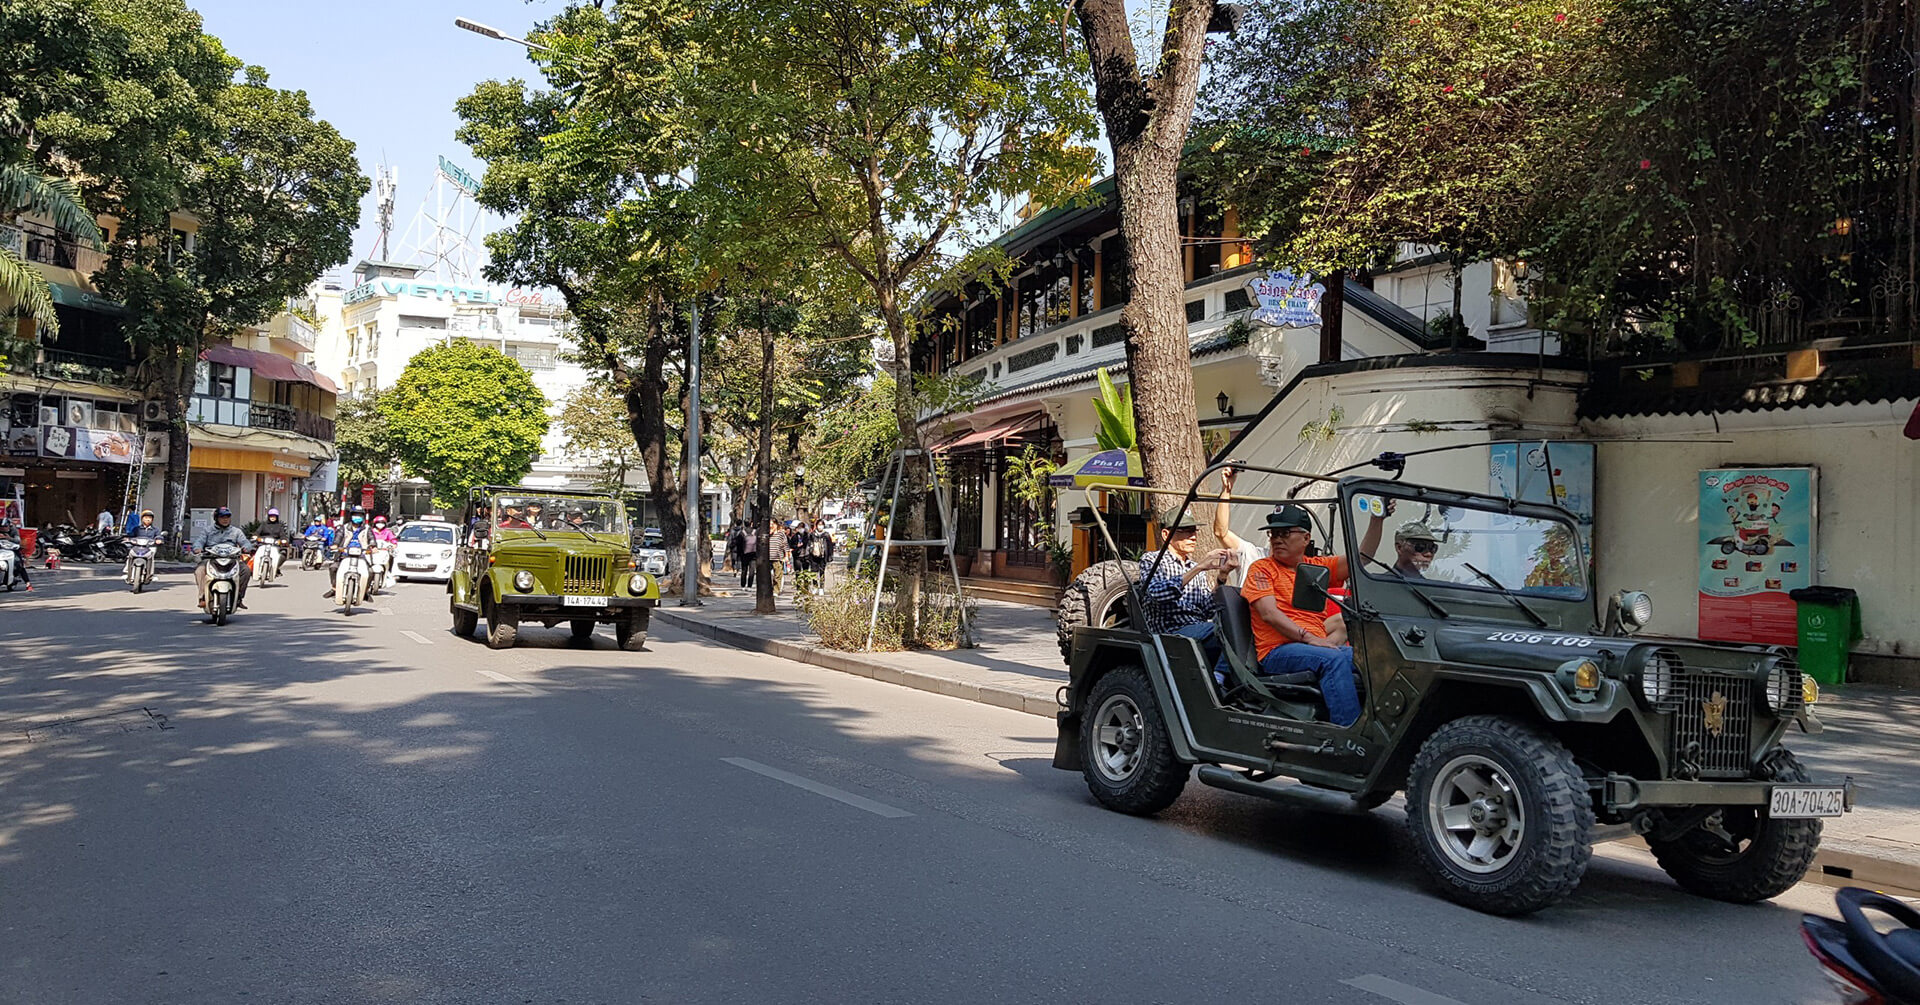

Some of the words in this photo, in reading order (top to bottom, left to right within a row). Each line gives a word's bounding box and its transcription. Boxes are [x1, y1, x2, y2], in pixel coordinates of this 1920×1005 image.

[1487, 631, 1543, 644] 2036
[1551, 636, 1594, 648] 105
[1346, 740, 1366, 757] US
[1773, 791, 1841, 813] 30A-704.25
